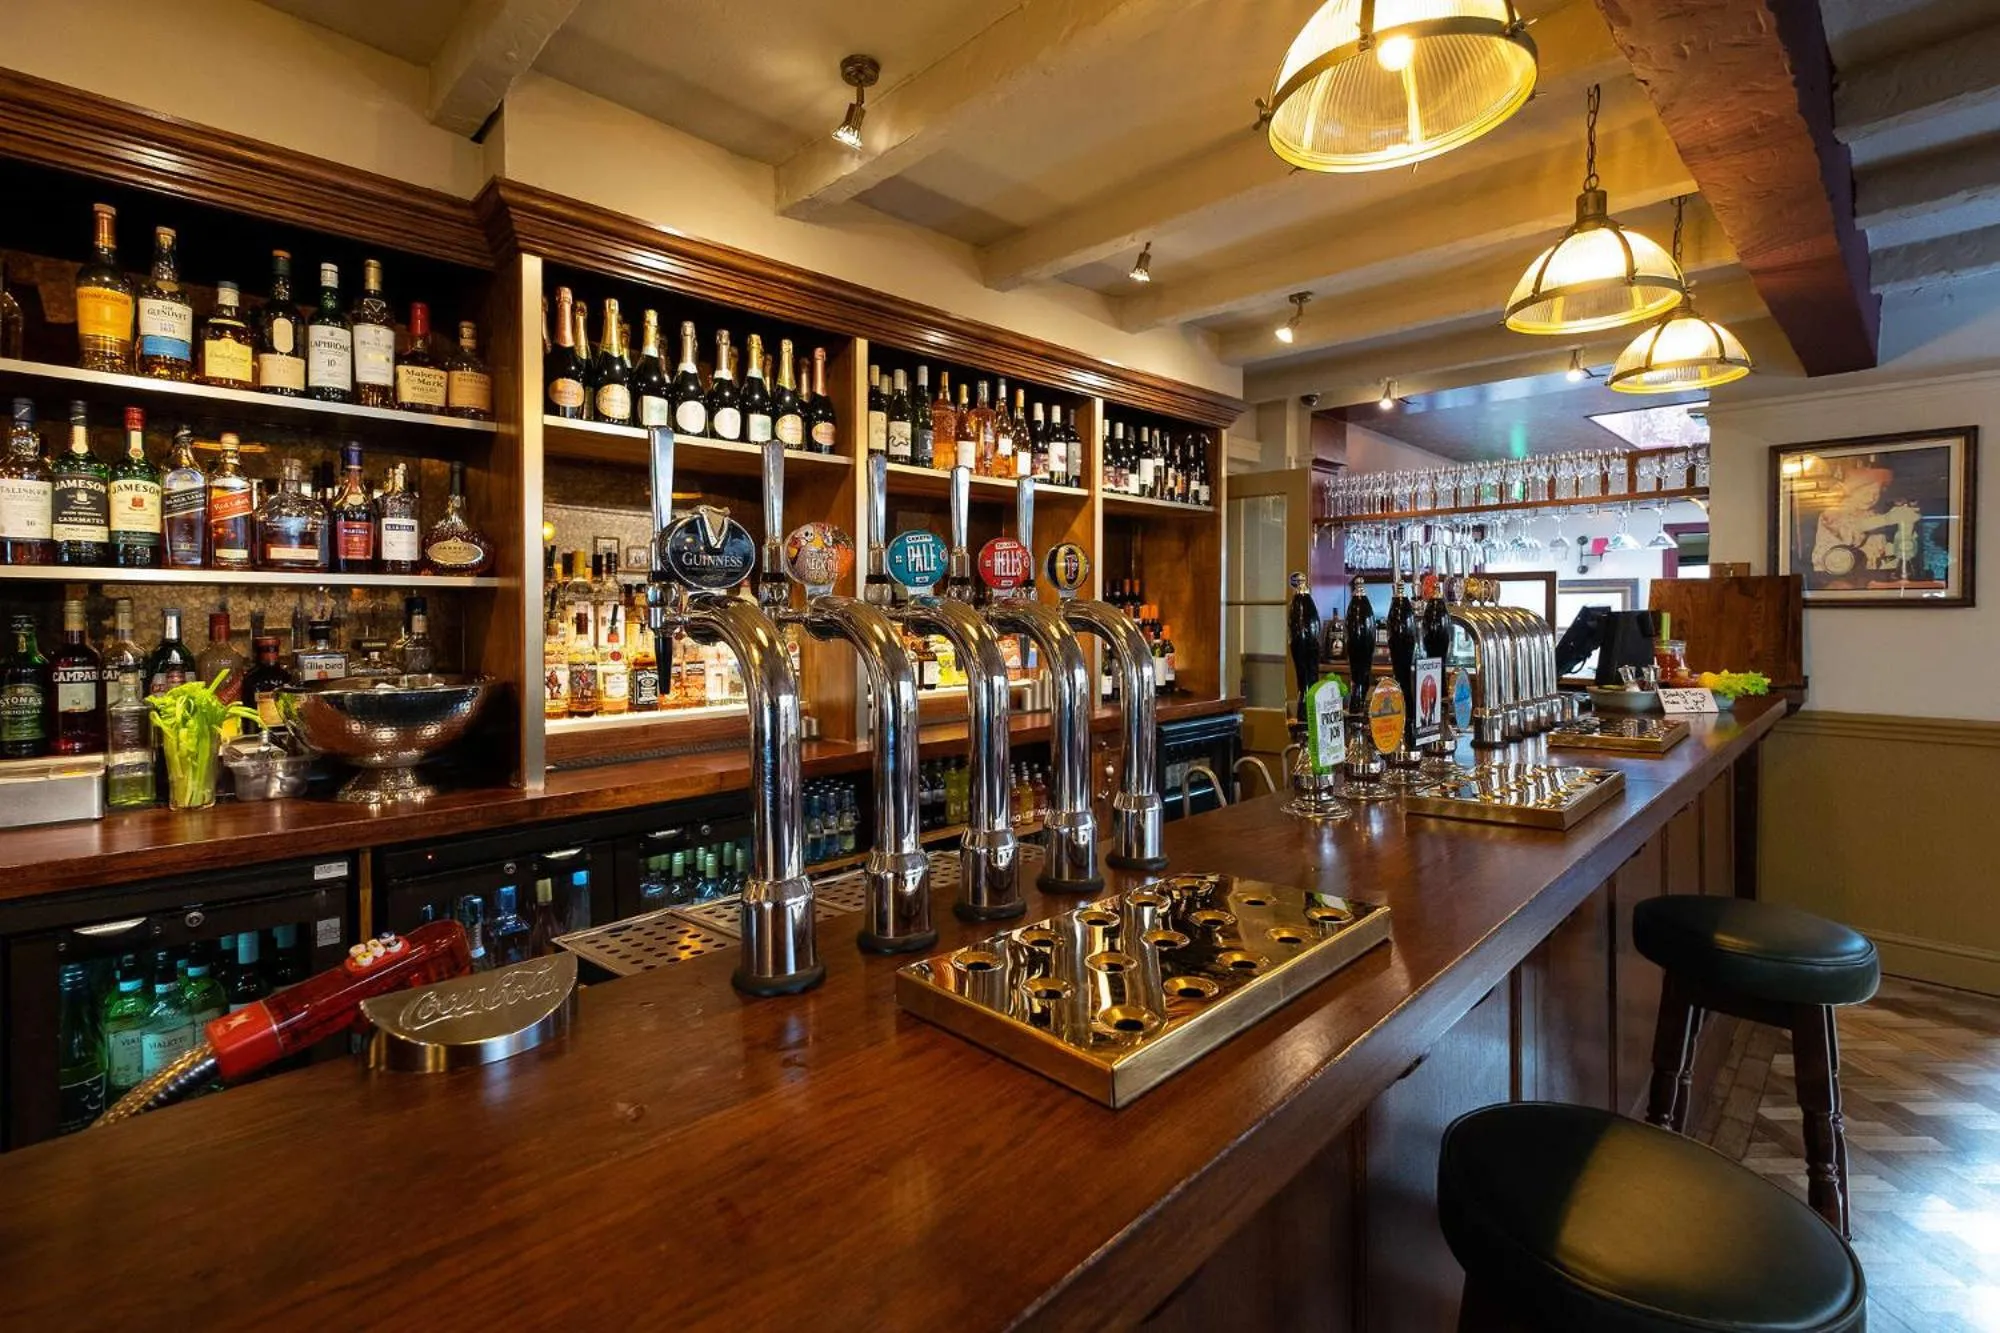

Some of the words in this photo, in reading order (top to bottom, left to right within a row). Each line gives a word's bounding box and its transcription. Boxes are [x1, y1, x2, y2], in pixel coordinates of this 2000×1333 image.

[417, 378, 444, 388] Mark
[54, 479, 107, 494] JAMESON
[111, 483, 161, 497] JAMESON
[681, 551, 744, 568] GUINNESS
[907, 543, 937, 573] PALE
